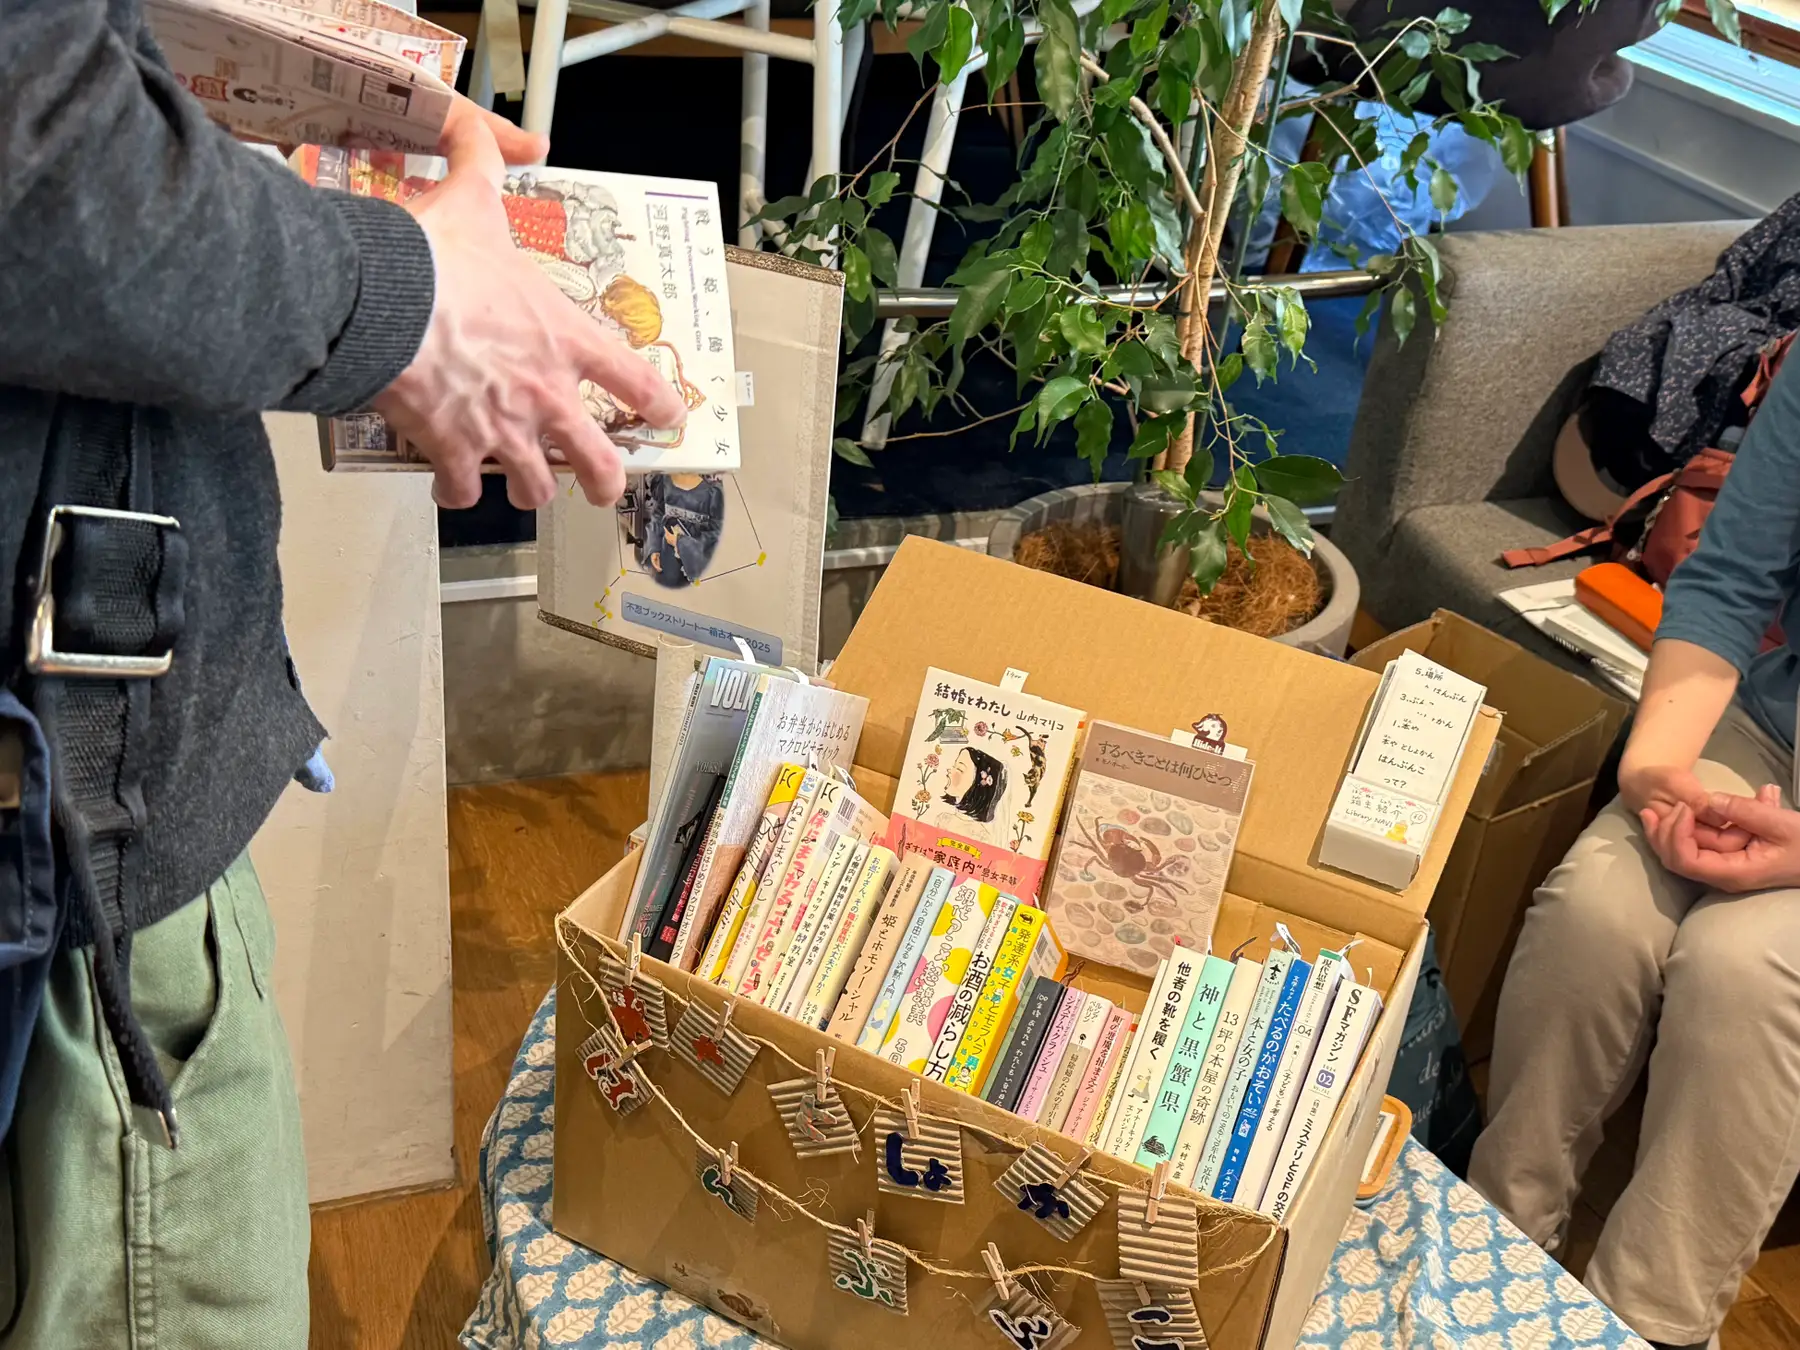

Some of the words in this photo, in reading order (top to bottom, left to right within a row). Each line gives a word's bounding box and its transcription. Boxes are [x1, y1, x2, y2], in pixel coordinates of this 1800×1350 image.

[626, 601, 743, 642] 不忍ブックストリート一箱古本
[776, 711, 851, 742] お弁当からはじめる
[934, 682, 1011, 717] 結婚とわたし
[1016, 709, 1065, 732] 山内マリコ
[1098, 740, 1233, 787] するべきことは何ひとつ
[1378, 754, 1426, 776] はんぶんこ
[1345, 808, 1373, 823] Library
[754, 801, 807, 903] ねこじまぐらし
[839, 912, 897, 1025] 姫とホモソーシャル
[882, 960, 907, 999] 沈黙入門
[1313, 957, 1332, 990] 現代思想
[923, 950, 991, 1081] お酒の減らし方
[1038, 995, 1077, 1073] システム・クラッシュ
[1147, 960, 1192, 1060] 他者の靴を履く
[1326, 986, 1363, 1064] SFマガジン
[1158, 983, 1220, 1113] 神と黒蟹県
[1188, 1010, 1239, 1126] 13坪の本屋の奇跡
[1231, 1014, 1265, 1084] 本と女の子
[1246, 1000, 1294, 1107] たべるのがおそい
[1316, 1072, 1334, 1086] 02
[1110, 1104, 1134, 1156] エンパシーのす
[885, 1131, 953, 1192] しょ
